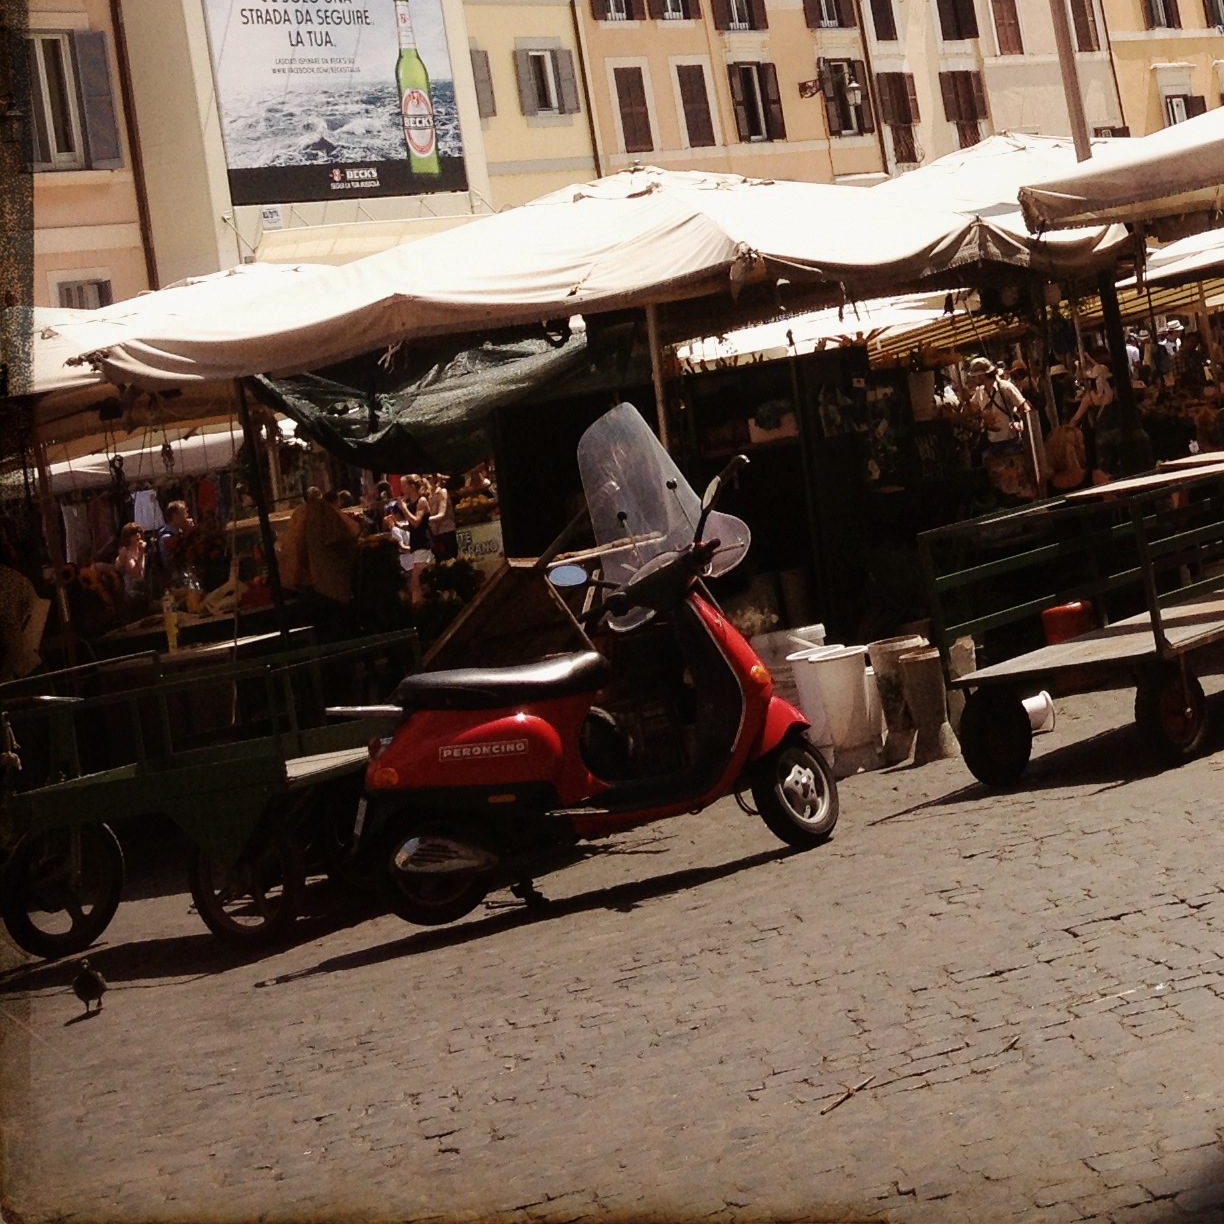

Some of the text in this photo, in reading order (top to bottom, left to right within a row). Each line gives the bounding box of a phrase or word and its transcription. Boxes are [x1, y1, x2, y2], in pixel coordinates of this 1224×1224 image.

[240, 8, 292, 25] STRADA
[294, 8, 314, 25] DA
[287, 30, 337, 48] LA TUA.
[403, 116, 434, 127] BECK'S
[345, 168, 378, 179] BECK'S
[442, 742, 526, 758] PERONCINO
